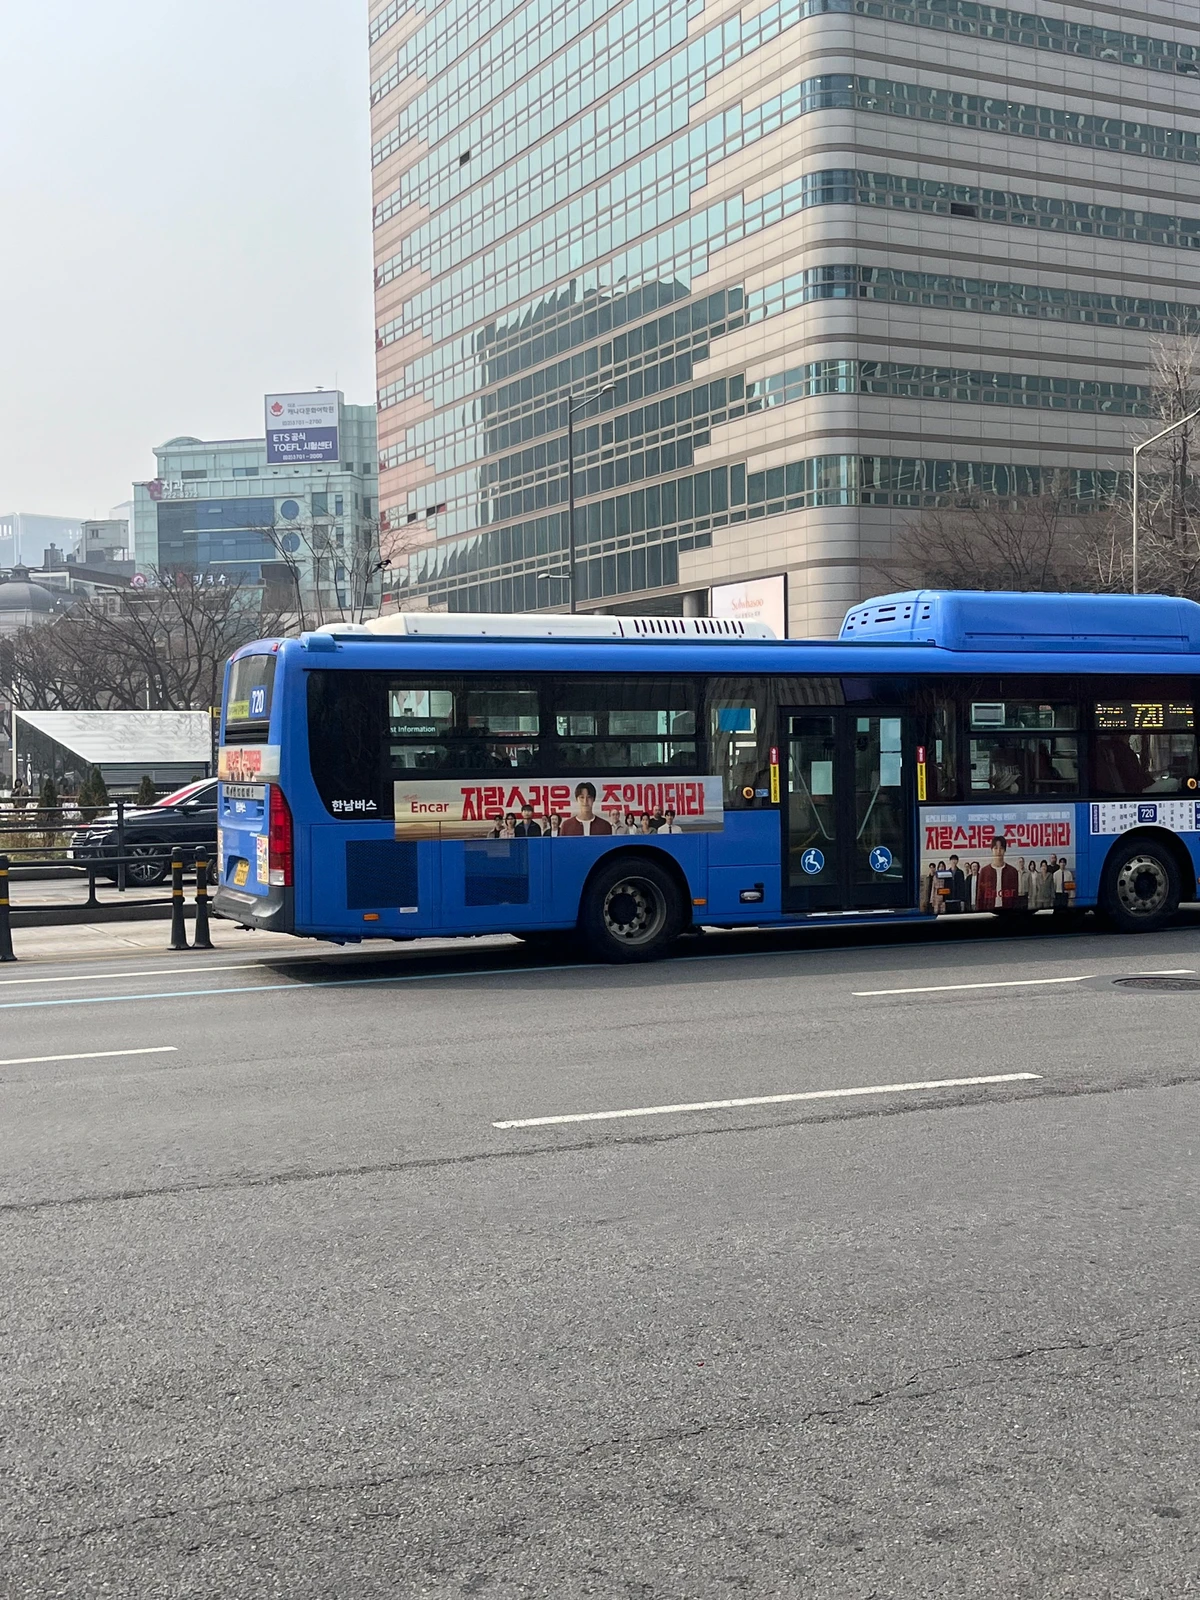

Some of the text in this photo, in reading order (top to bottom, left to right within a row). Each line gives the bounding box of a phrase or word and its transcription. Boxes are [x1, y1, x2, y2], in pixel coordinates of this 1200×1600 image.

[273, 432, 306, 442] ETS 공식
[273, 441, 333, 452] TOEFL 시험센터
[252, 689, 265, 713] 720
[1131, 704, 1164, 727] 720
[398, 725, 436, 733] Information
[331, 799, 378, 812] 한남버스
[411, 801, 449, 813] Encar
[461, 785, 571, 820] 자랑스러운
[1141, 808, 1154, 818] 720
[925, 825, 995, 850] 자랑스러운
